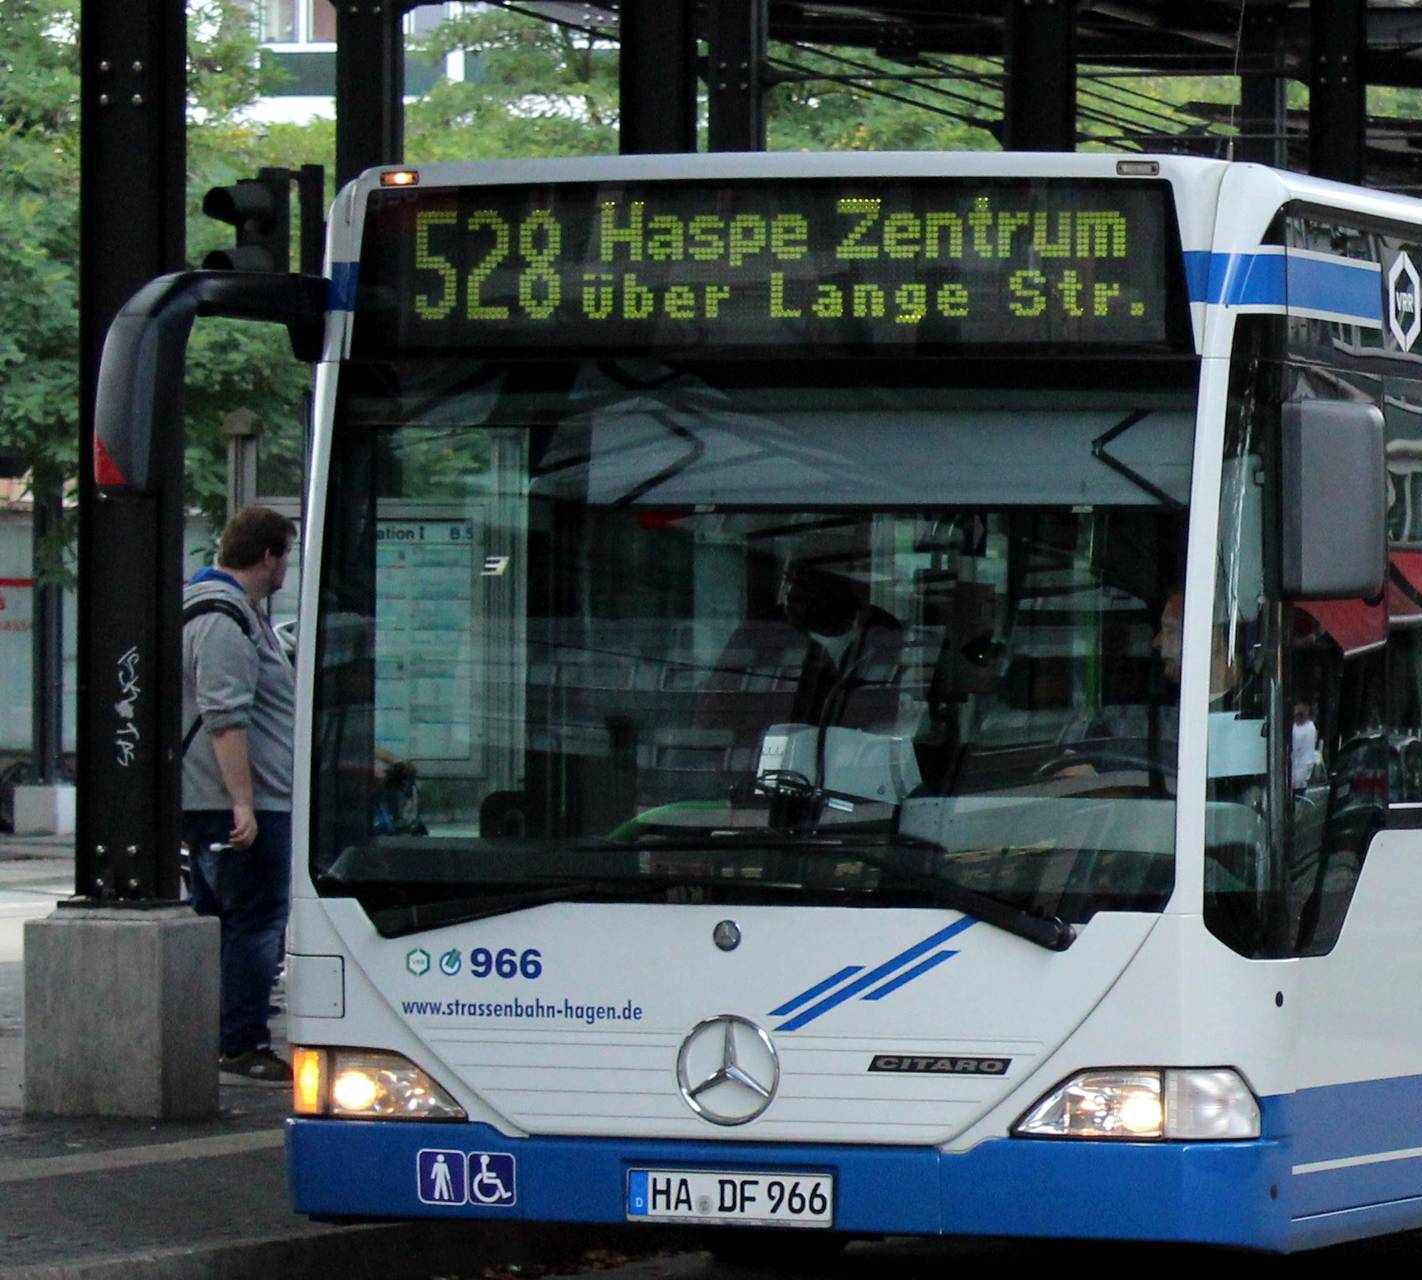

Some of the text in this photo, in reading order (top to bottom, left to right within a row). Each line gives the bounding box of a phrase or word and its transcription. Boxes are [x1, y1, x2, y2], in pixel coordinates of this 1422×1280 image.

[600, 197, 1127, 267] Haspe Zentrum
[416, 210, 562, 320] 528
[583, 270, 1145, 323] über Lange Str.
[1396, 292, 1414, 312] VRR
[470, 947, 543, 980] 966
[402, 997, 643, 1025] www.strassenbahn-hagen.de
[875, 1057, 1004, 1073] CITARO
[652, 1177, 828, 1215] HA DF 966
